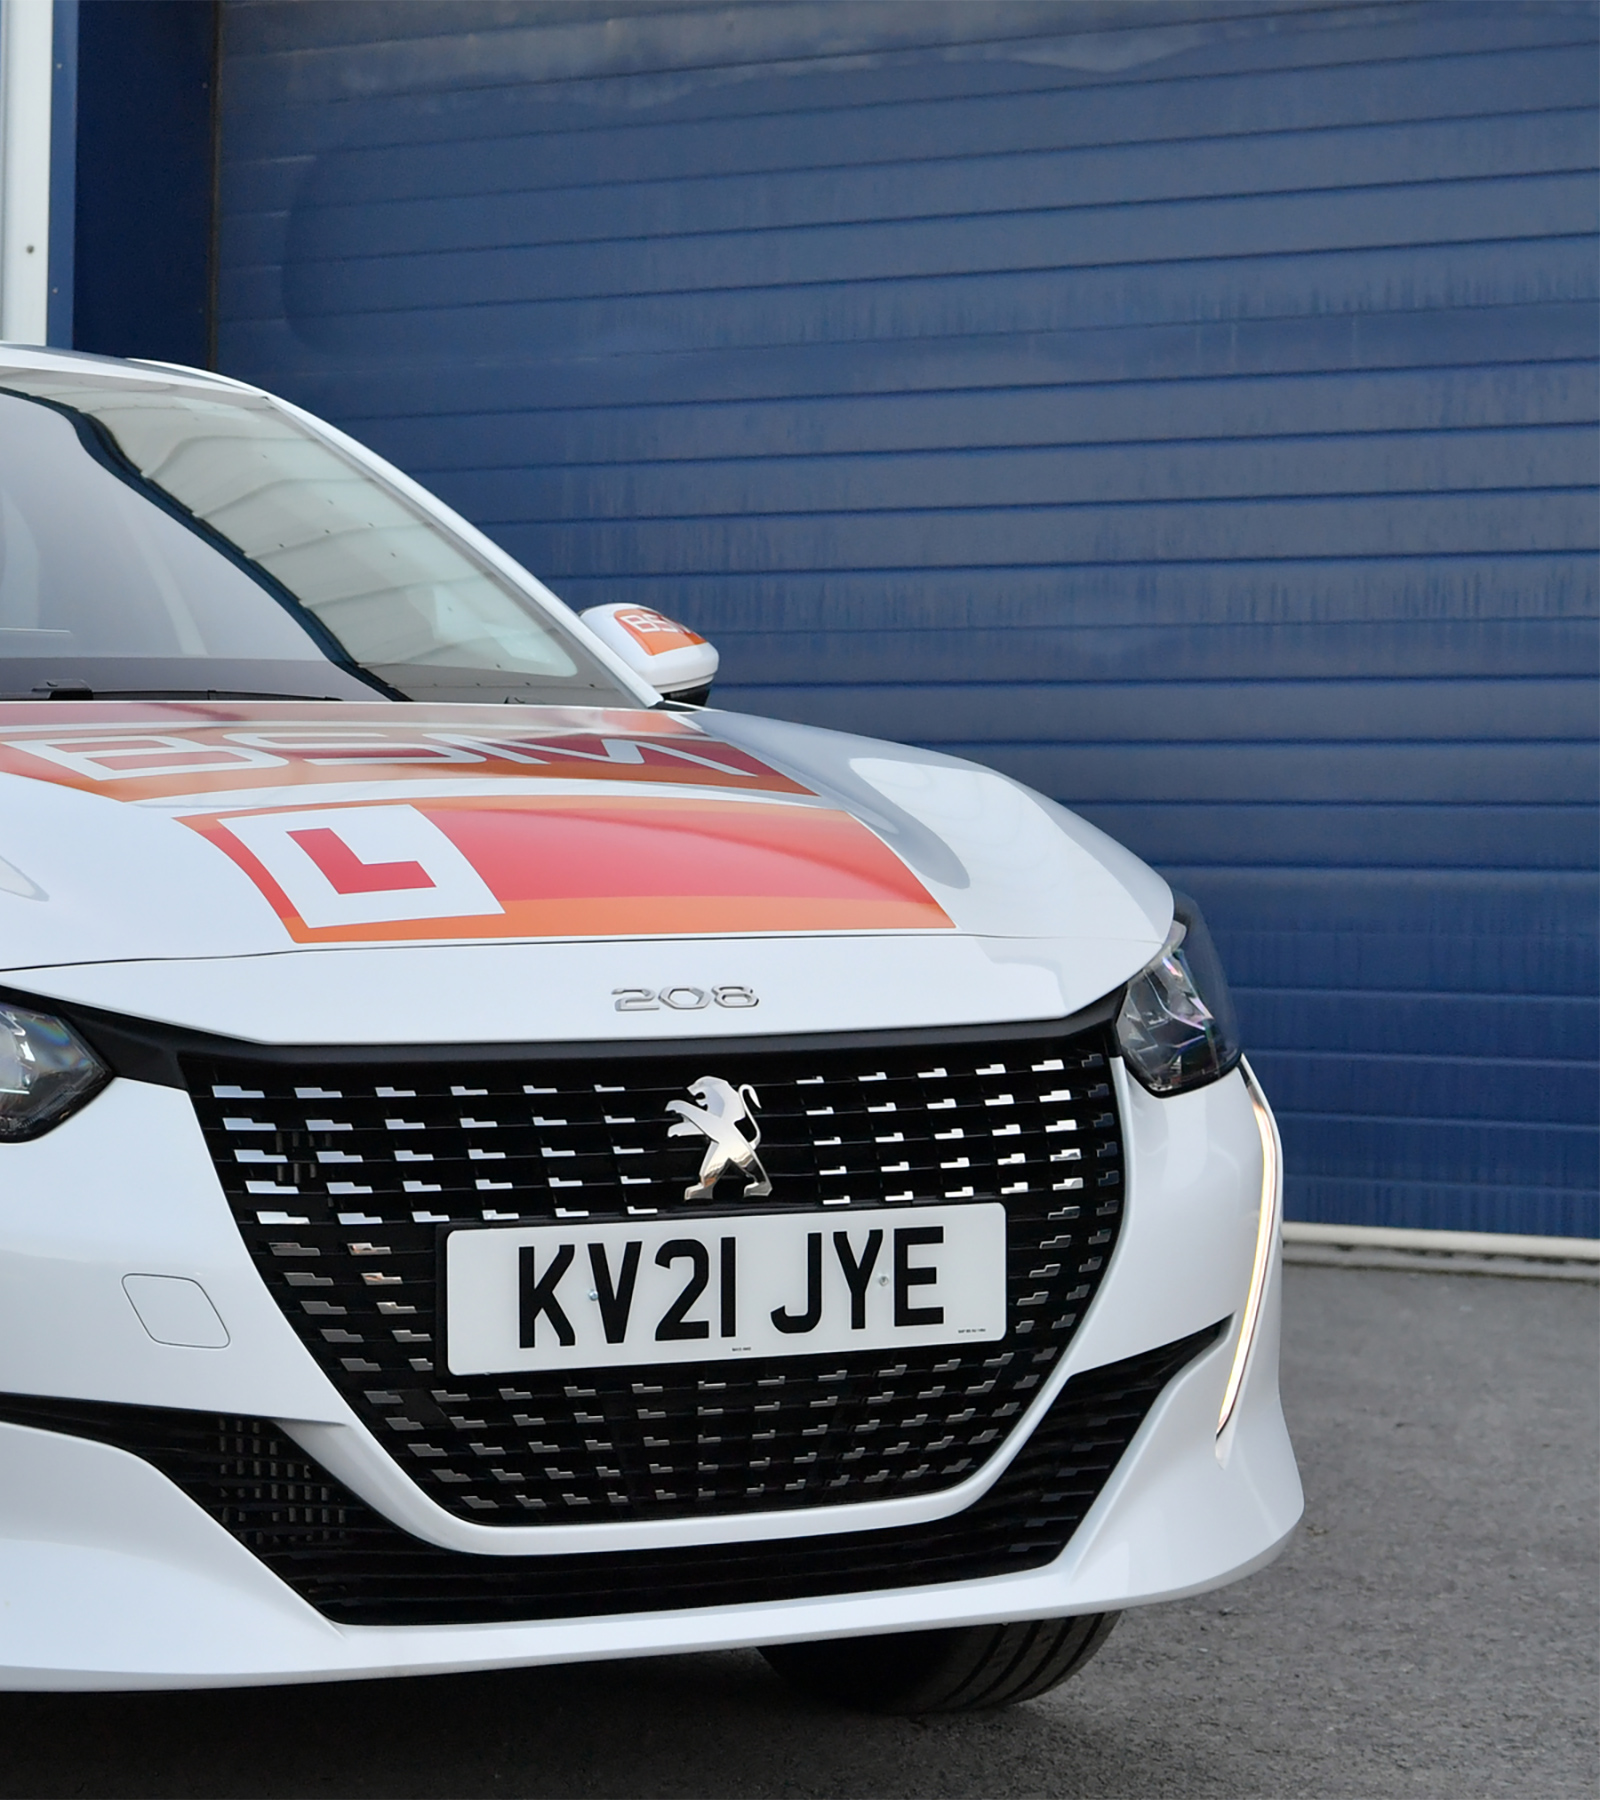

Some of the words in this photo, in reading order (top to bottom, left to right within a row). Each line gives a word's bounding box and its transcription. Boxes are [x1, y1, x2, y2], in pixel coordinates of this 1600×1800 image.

[0, 732, 758, 782] BSM
[286, 827, 437, 895] L
[611, 984, 760, 1012] 208
[518, 1236, 737, 1349] KV21
[769, 1226, 945, 1335] JYE
